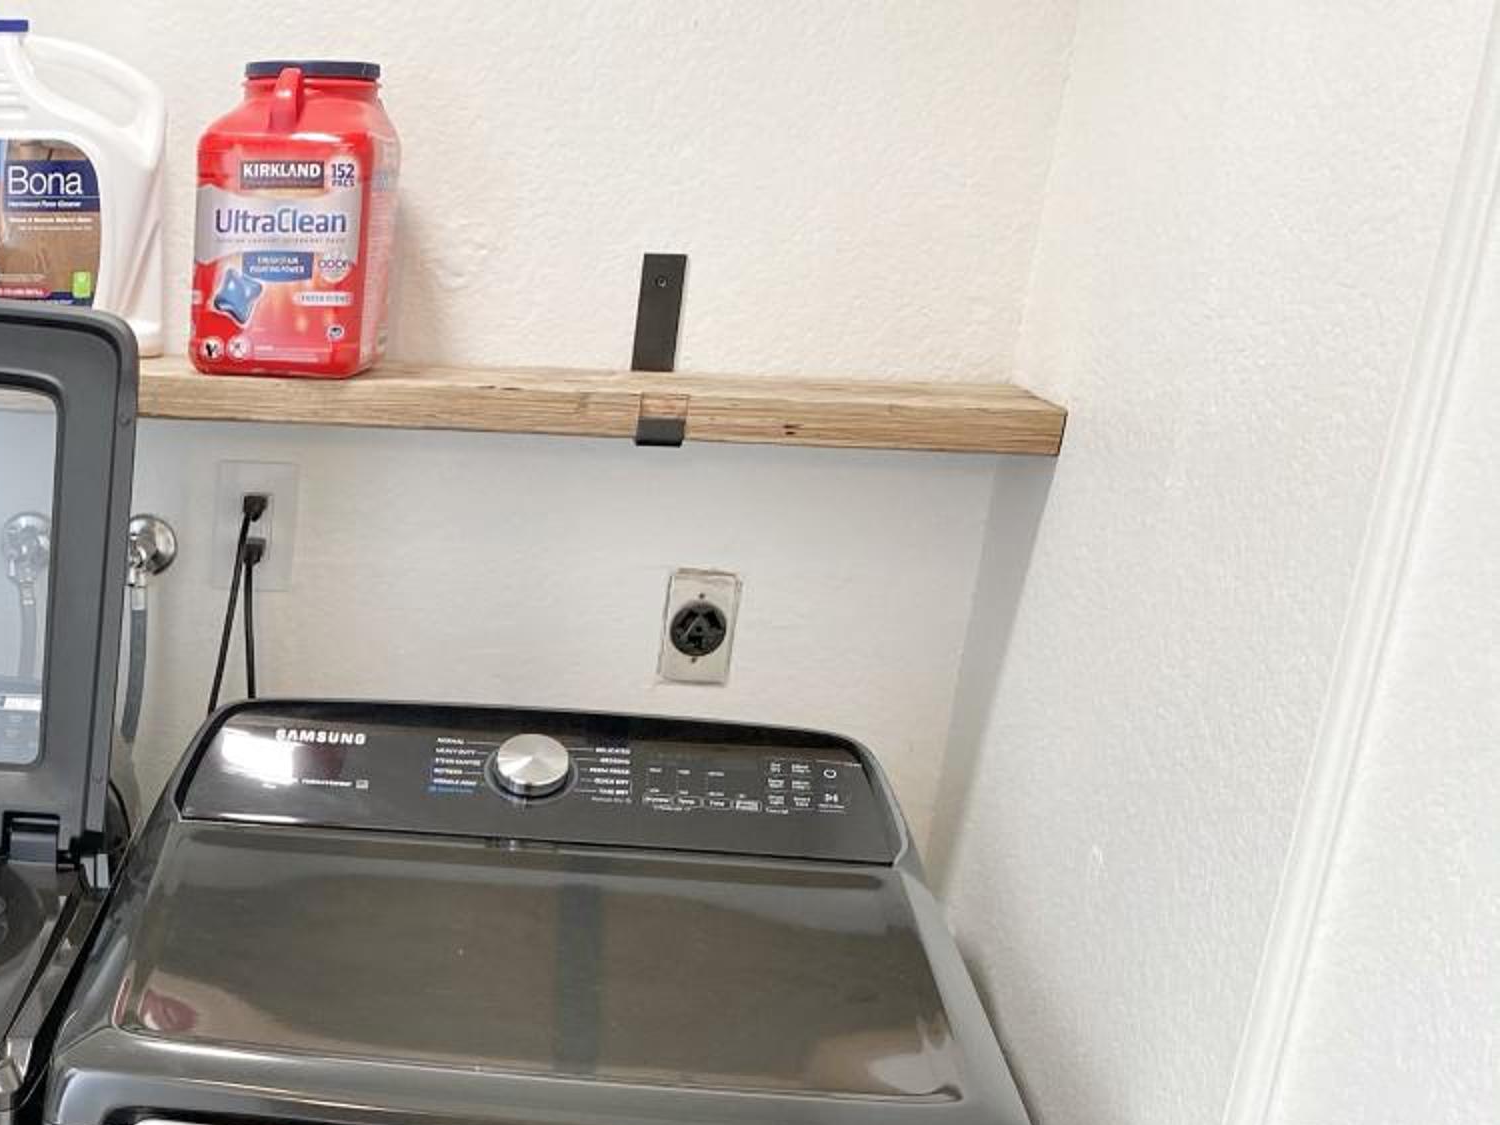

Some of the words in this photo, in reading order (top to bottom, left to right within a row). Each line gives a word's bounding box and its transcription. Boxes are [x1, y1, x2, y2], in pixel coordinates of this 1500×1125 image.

[243, 163, 321, 177] KIRKLAND
[331, 163, 355, 179] 152
[7, 165, 83, 195] Bona
[215, 208, 346, 233] UltraClean
[276, 729, 367, 745] SAMSUNG
